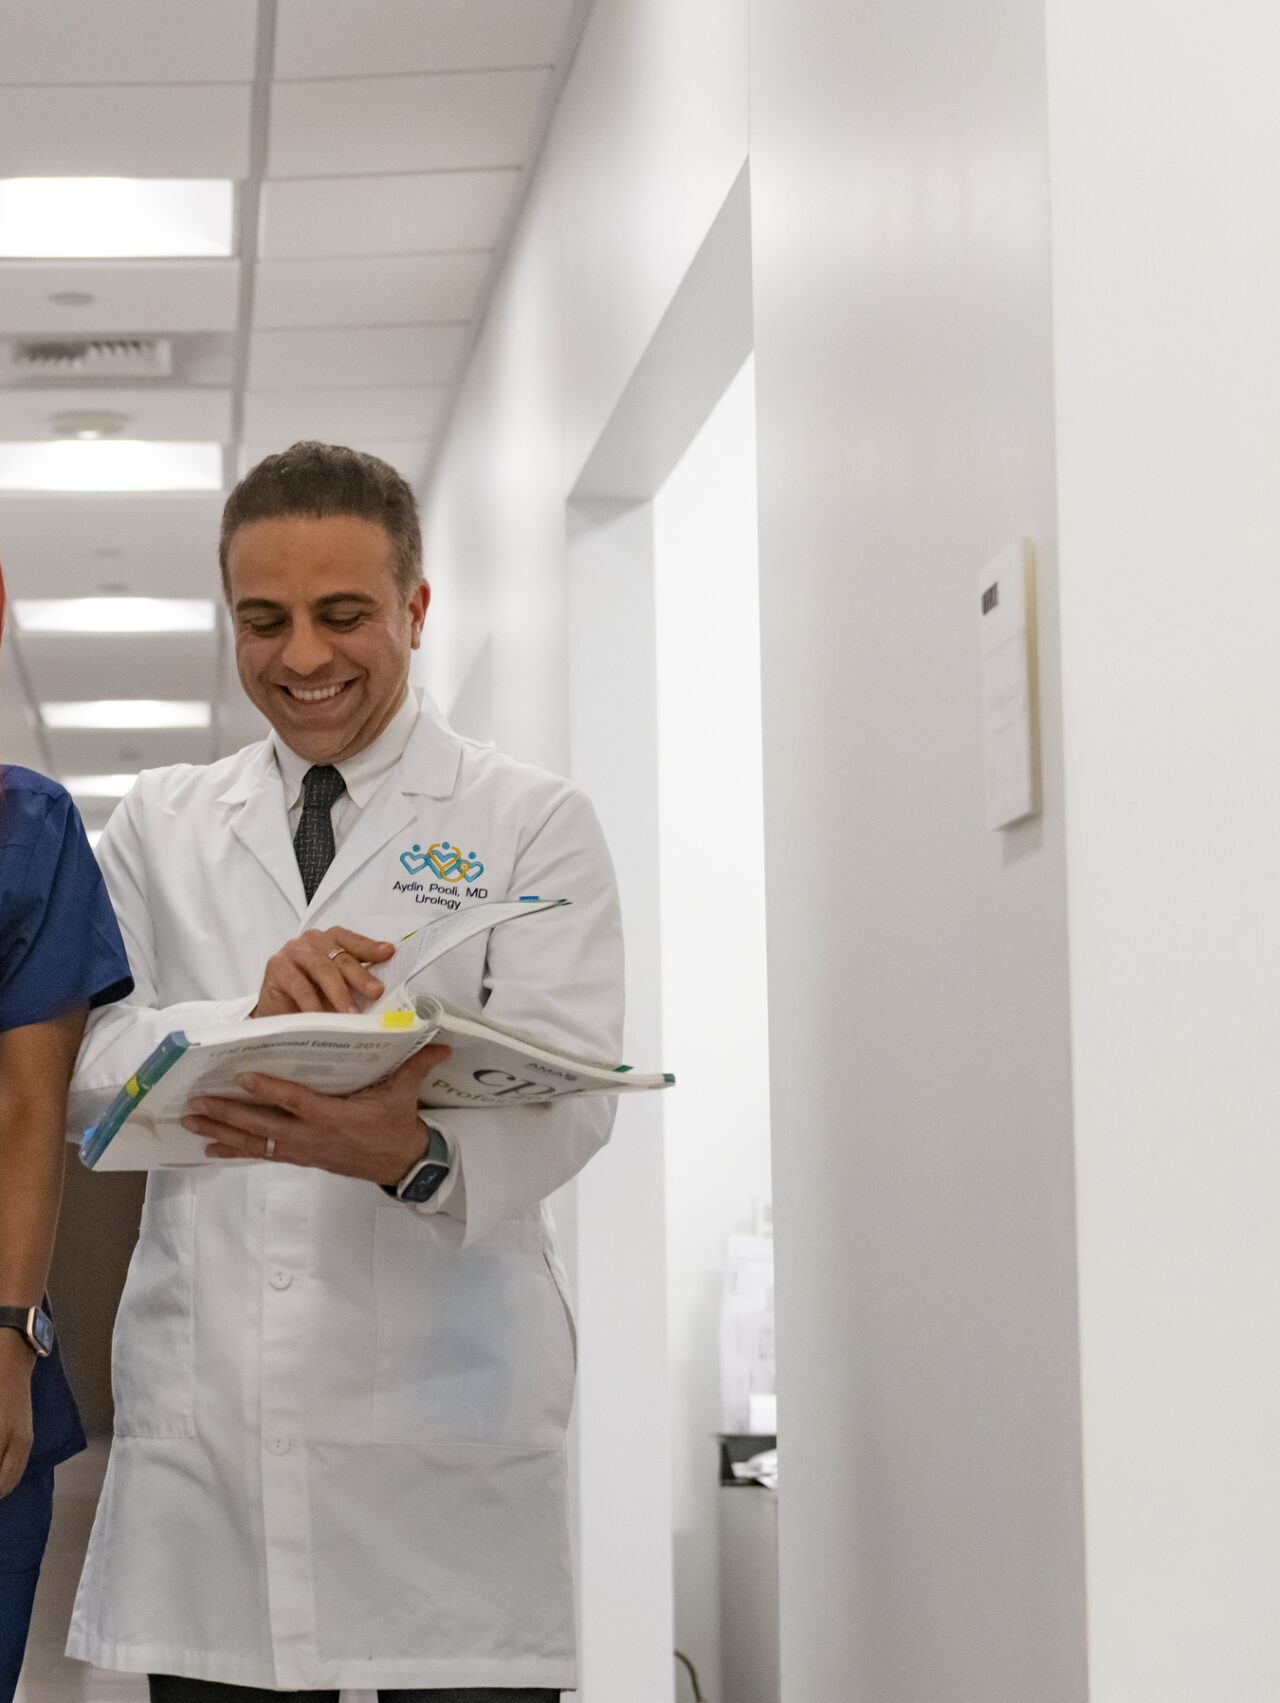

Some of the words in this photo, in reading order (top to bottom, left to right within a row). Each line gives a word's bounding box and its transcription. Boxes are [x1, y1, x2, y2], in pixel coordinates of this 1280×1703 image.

[393, 881, 424, 894] Aydin
[429, 883, 464, 897] Pooli,
[470, 887, 489, 899] MD
[415, 894, 461, 911] Urology
